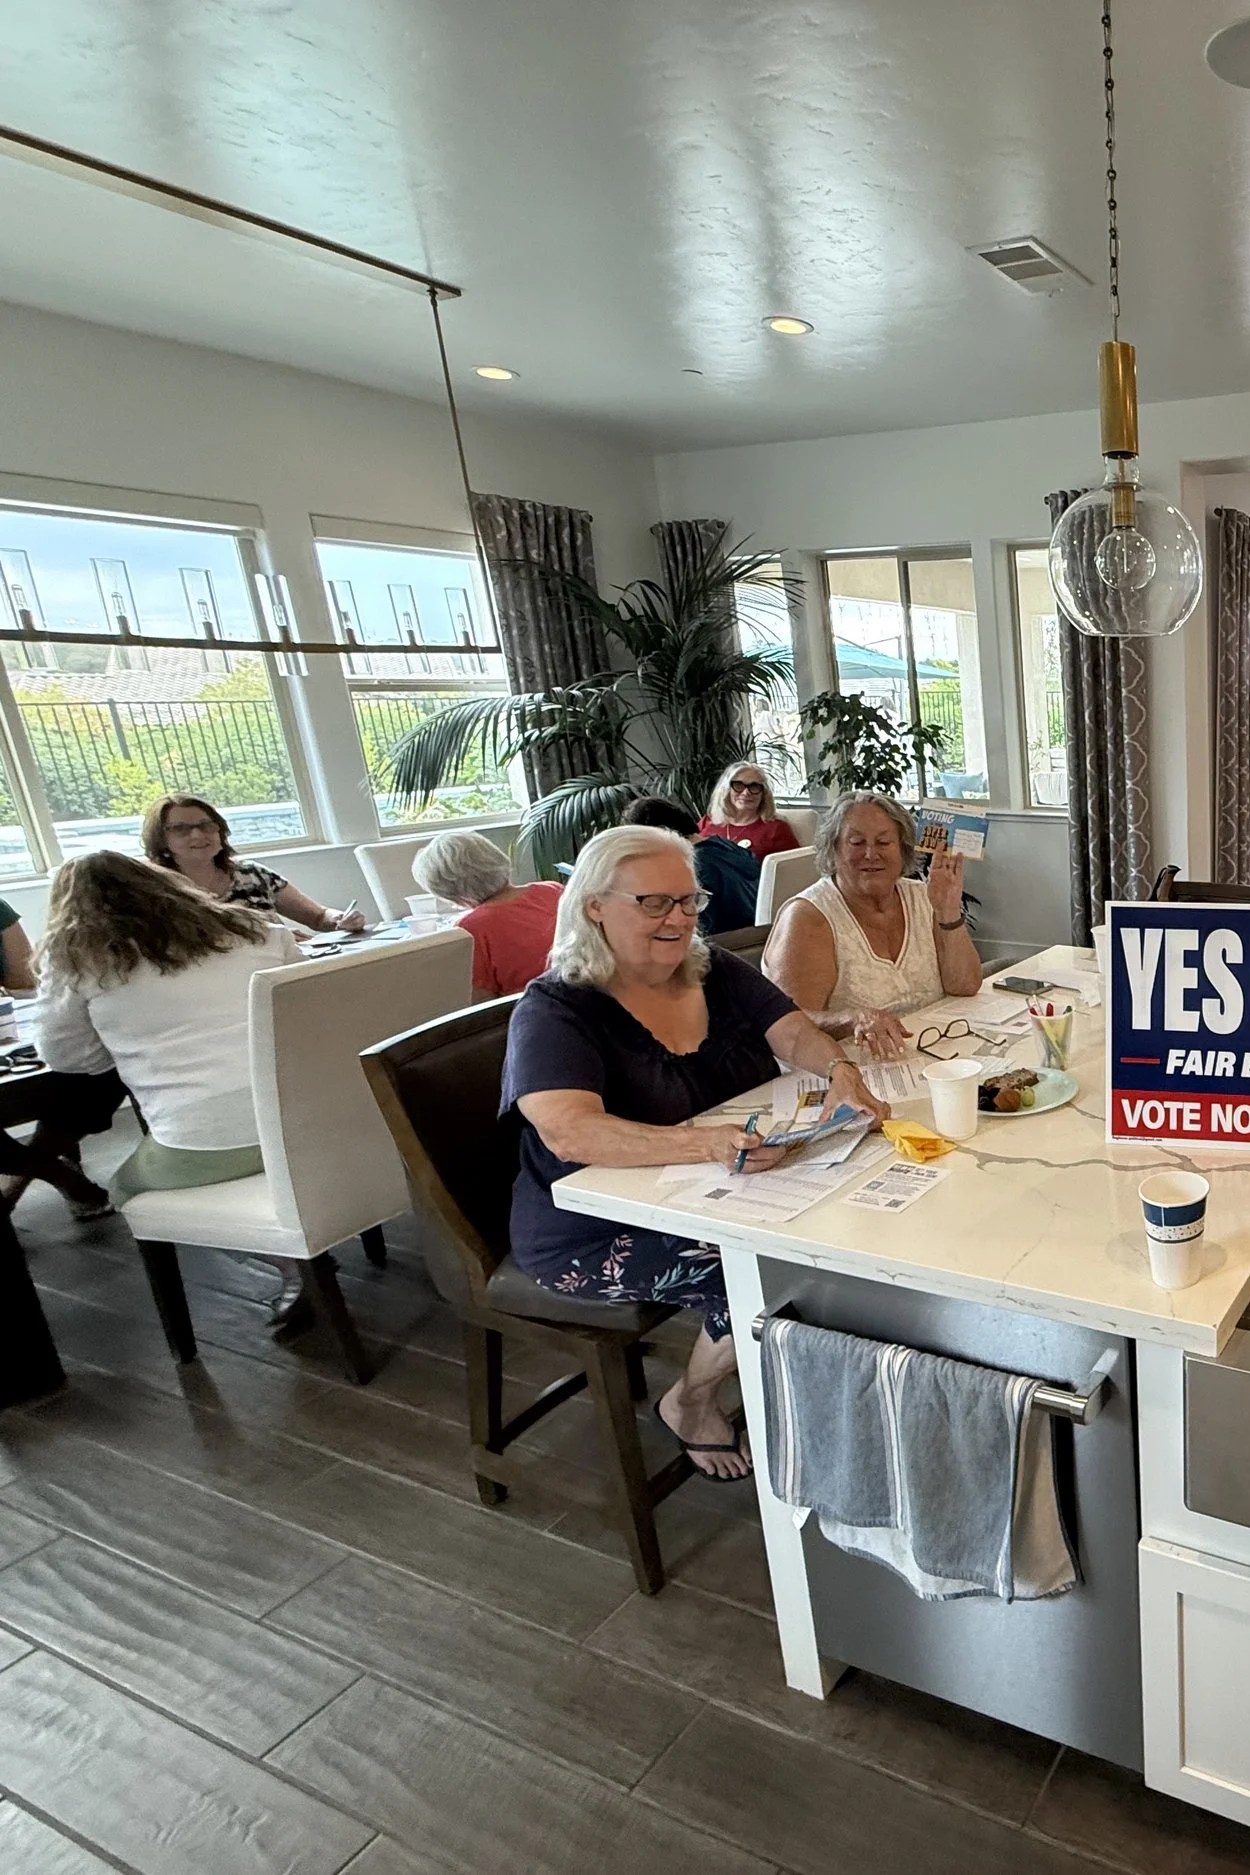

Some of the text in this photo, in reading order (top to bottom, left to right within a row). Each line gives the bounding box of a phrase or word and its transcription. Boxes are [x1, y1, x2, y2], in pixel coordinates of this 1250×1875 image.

[921, 810, 955, 824] VOTING
[1120, 928, 1244, 1036] YES
[1165, 1049, 1238, 1078] FAIR
[1120, 1099, 1201, 1131] VOTE
